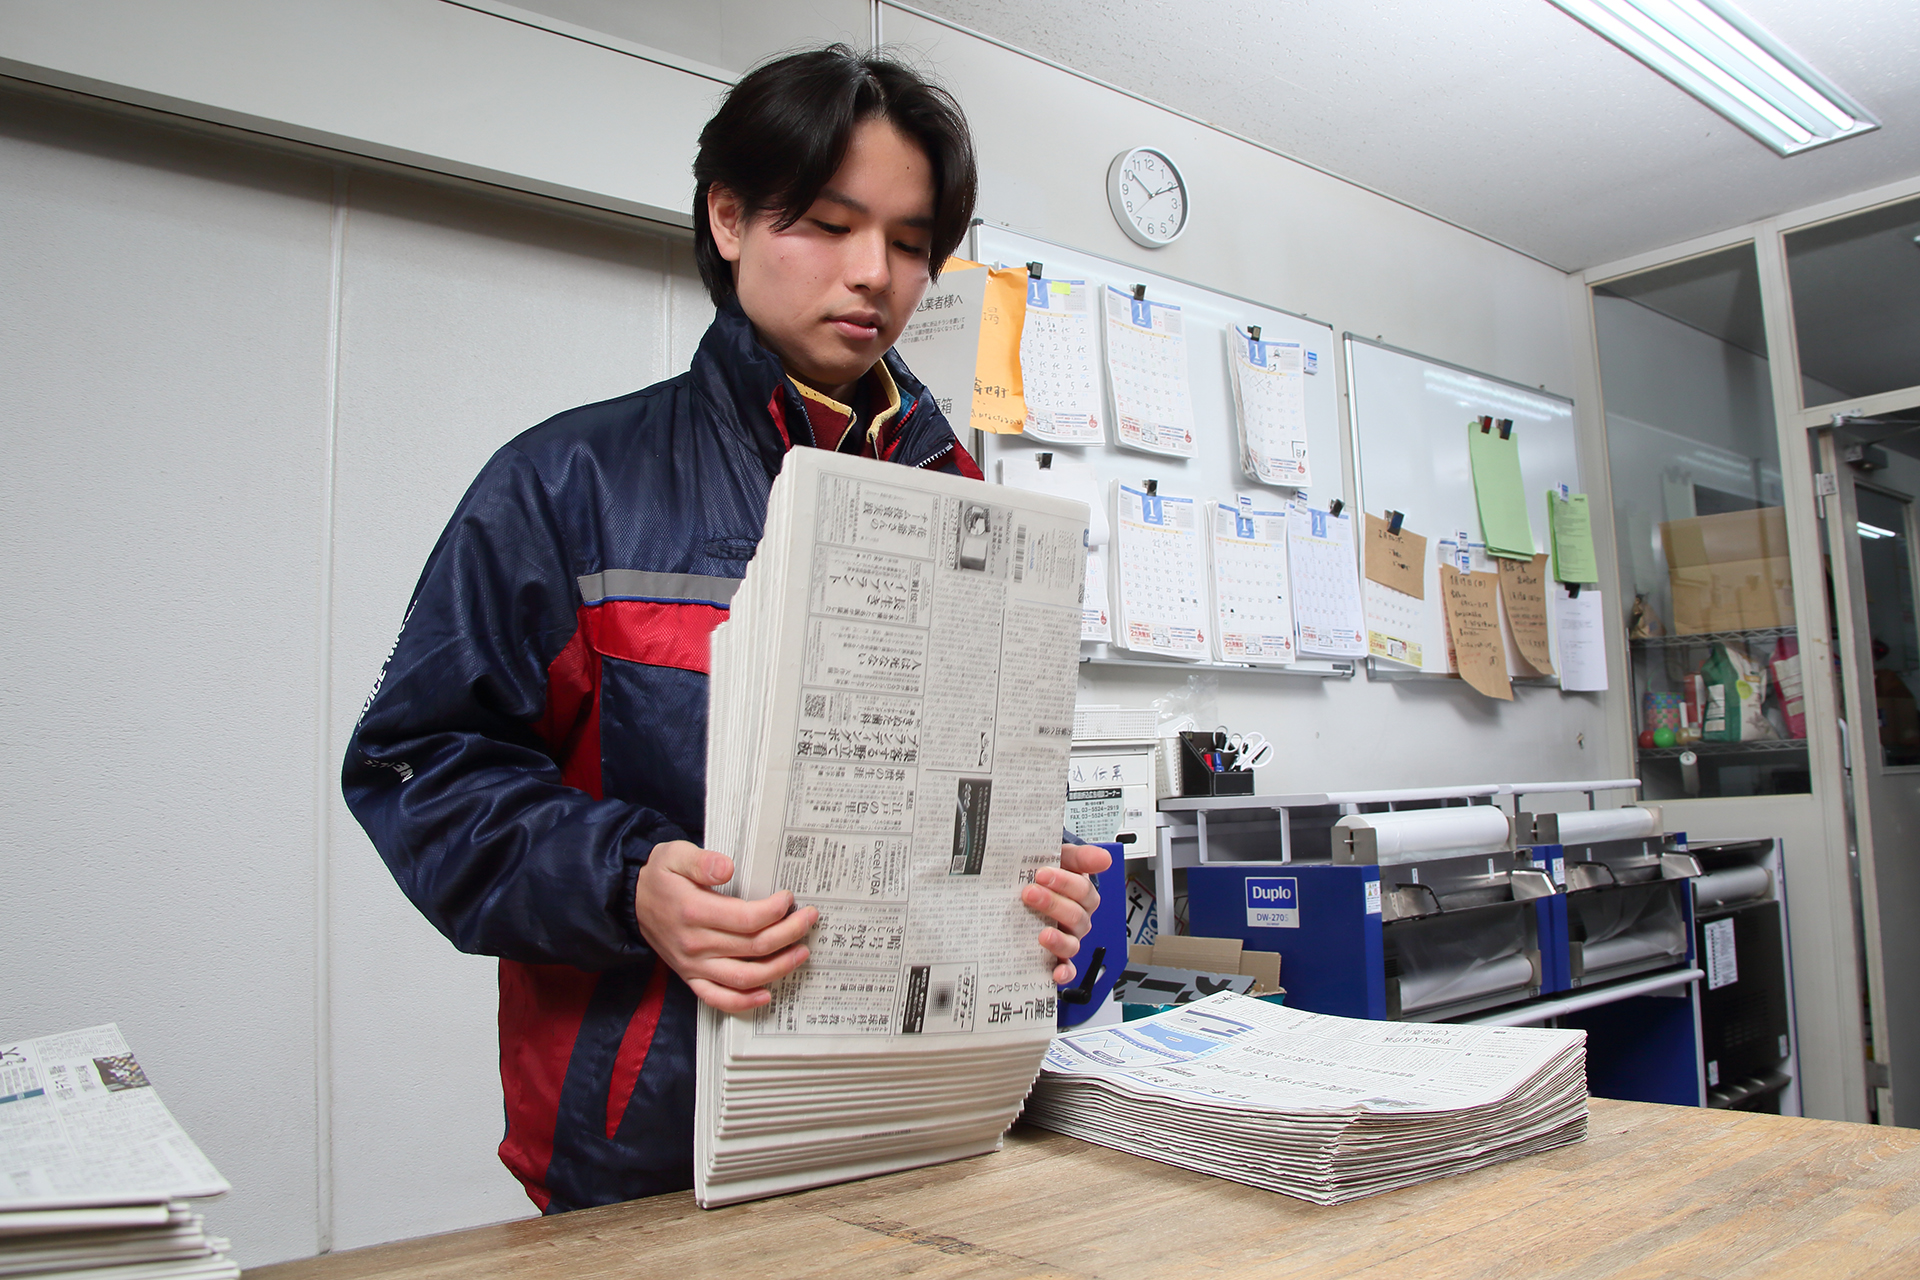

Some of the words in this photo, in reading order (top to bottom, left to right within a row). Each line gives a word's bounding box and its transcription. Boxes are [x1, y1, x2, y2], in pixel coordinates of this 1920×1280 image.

[1132, 159, 1141, 171] 11
[1144, 158, 1154, 171] 12
[1124, 168, 1134, 181] 10
[1160, 168, 1165, 179] 1
[1122, 183, 1129, 195] 9
[1126, 200, 1133, 212] 8
[1171, 197, 1178, 210] 3
[1136, 216, 1143, 226] 7
[1168, 213, 1174, 224] 4
[1147, 222, 1154, 234] 6
[1160, 222, 1167, 234] 5
[1031, 282, 1041, 300] 1
[1137, 302, 1145, 321] 1
[1253, 343, 1260, 359] 1
[1147, 499, 1156, 517] 1
[1316, 514, 1322, 531] 1
[829, 574, 907, 593] インプラント
[910, 579, 920, 603] 第1位
[866, 594, 906, 612] 長生き
[857, 652, 922, 671] 人は死なない
[860, 712, 914, 728] きぬた歯科
[799, 727, 919, 749] ブランディングボード
[796, 740, 918, 763] 集客する野立て看板
[1072, 764, 1124, 783] 込伝票
[844, 800, 904, 816] 江戸の色里
[1081, 804, 1119, 813] 03-5524-2919
[872, 840, 884, 870] Excel
[869, 872, 882, 896] VBA
[1252, 886, 1291, 902] Duplo
[1256, 913, 1289, 922] DW-270S
[811, 922, 904, 935] やさしく教えてくれる
[818, 932, 902, 950] 暗号資産を
[988, 995, 1056, 1024] 動産に1兆円
[806, 1013, 890, 1026] 地球科学の教科書
